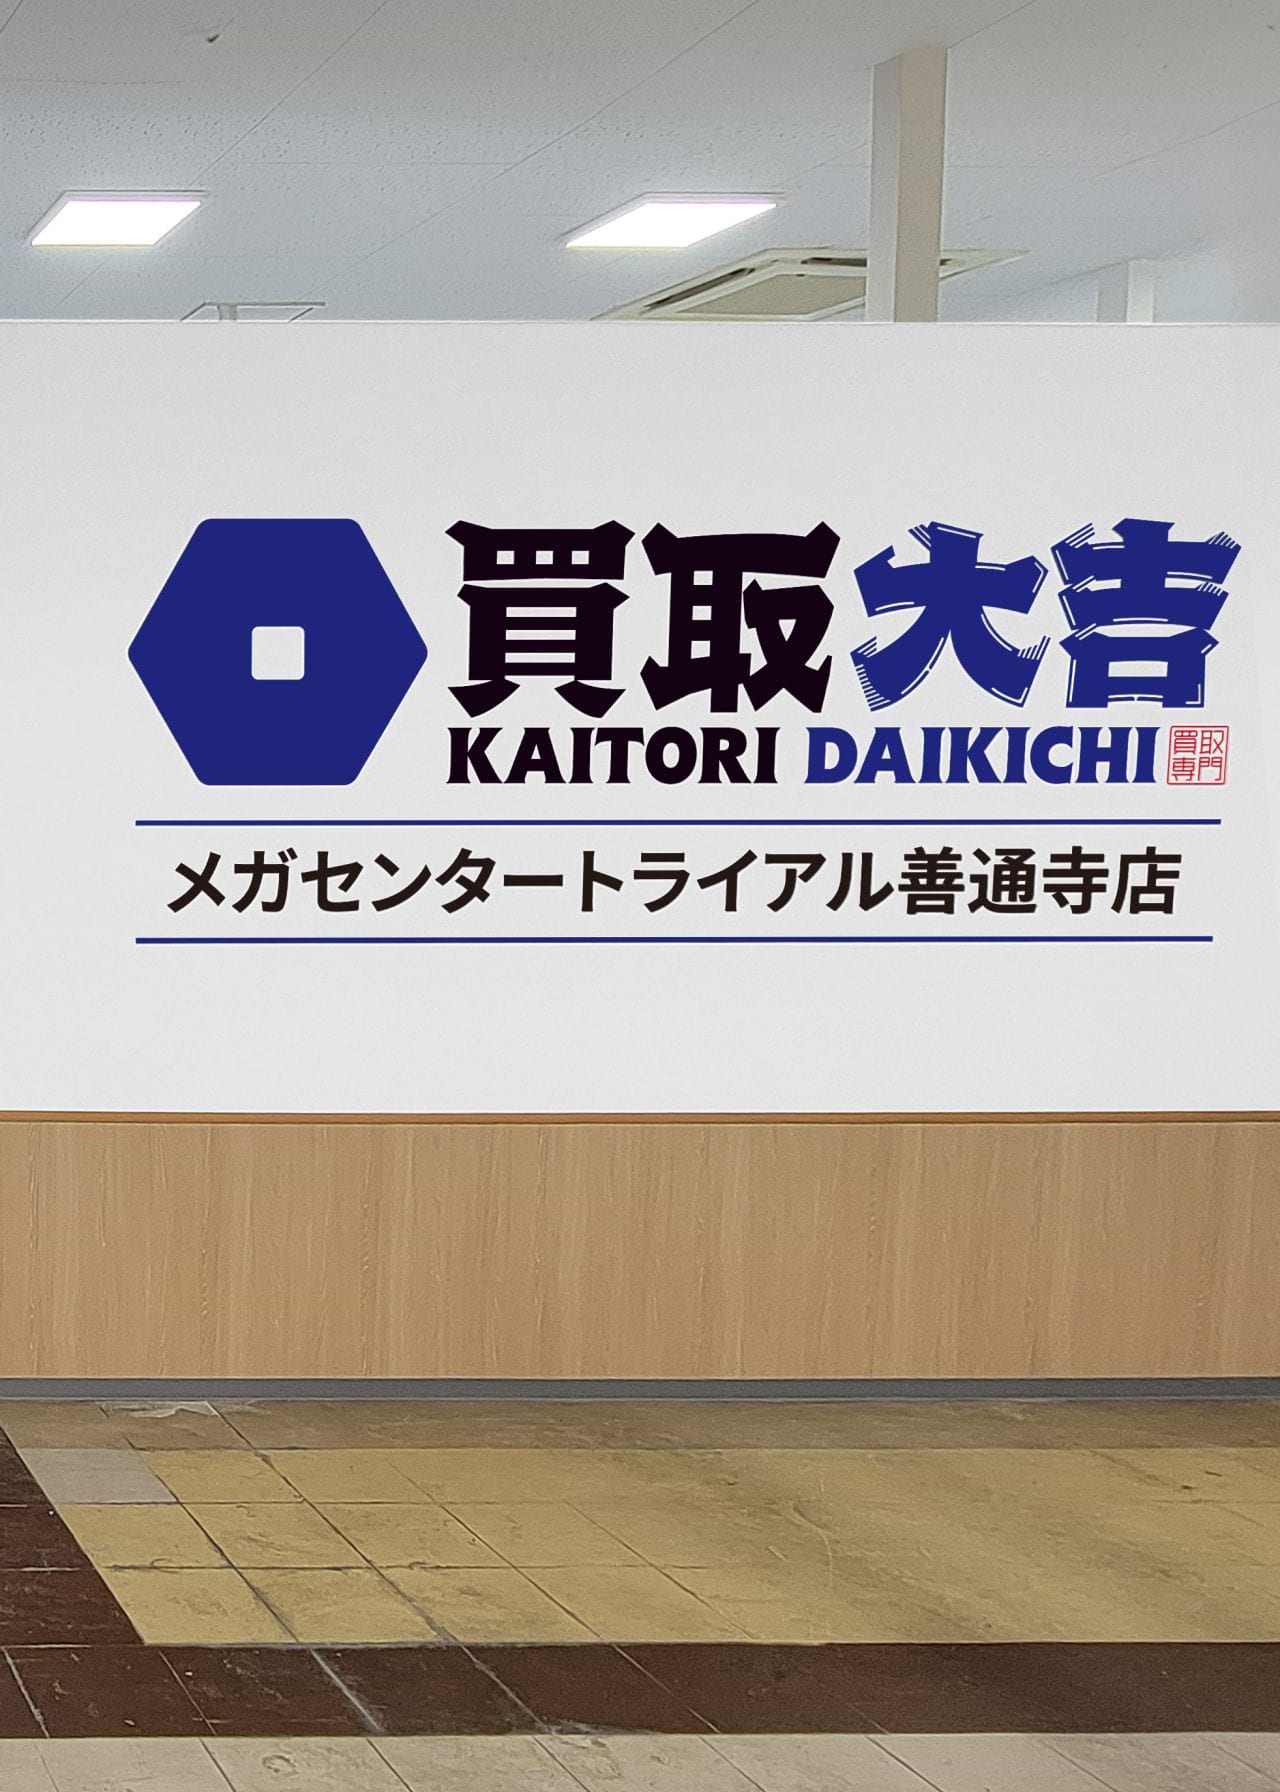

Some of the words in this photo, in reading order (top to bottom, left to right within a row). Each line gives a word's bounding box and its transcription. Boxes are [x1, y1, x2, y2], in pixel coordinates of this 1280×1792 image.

[445, 518, 1242, 718] 買取大吉
[447, 727, 780, 784] KAITORI
[805, 726, 1158, 784] DAIKICHI
[168, 846, 1181, 914] メガセンタートライアル善通寺店
